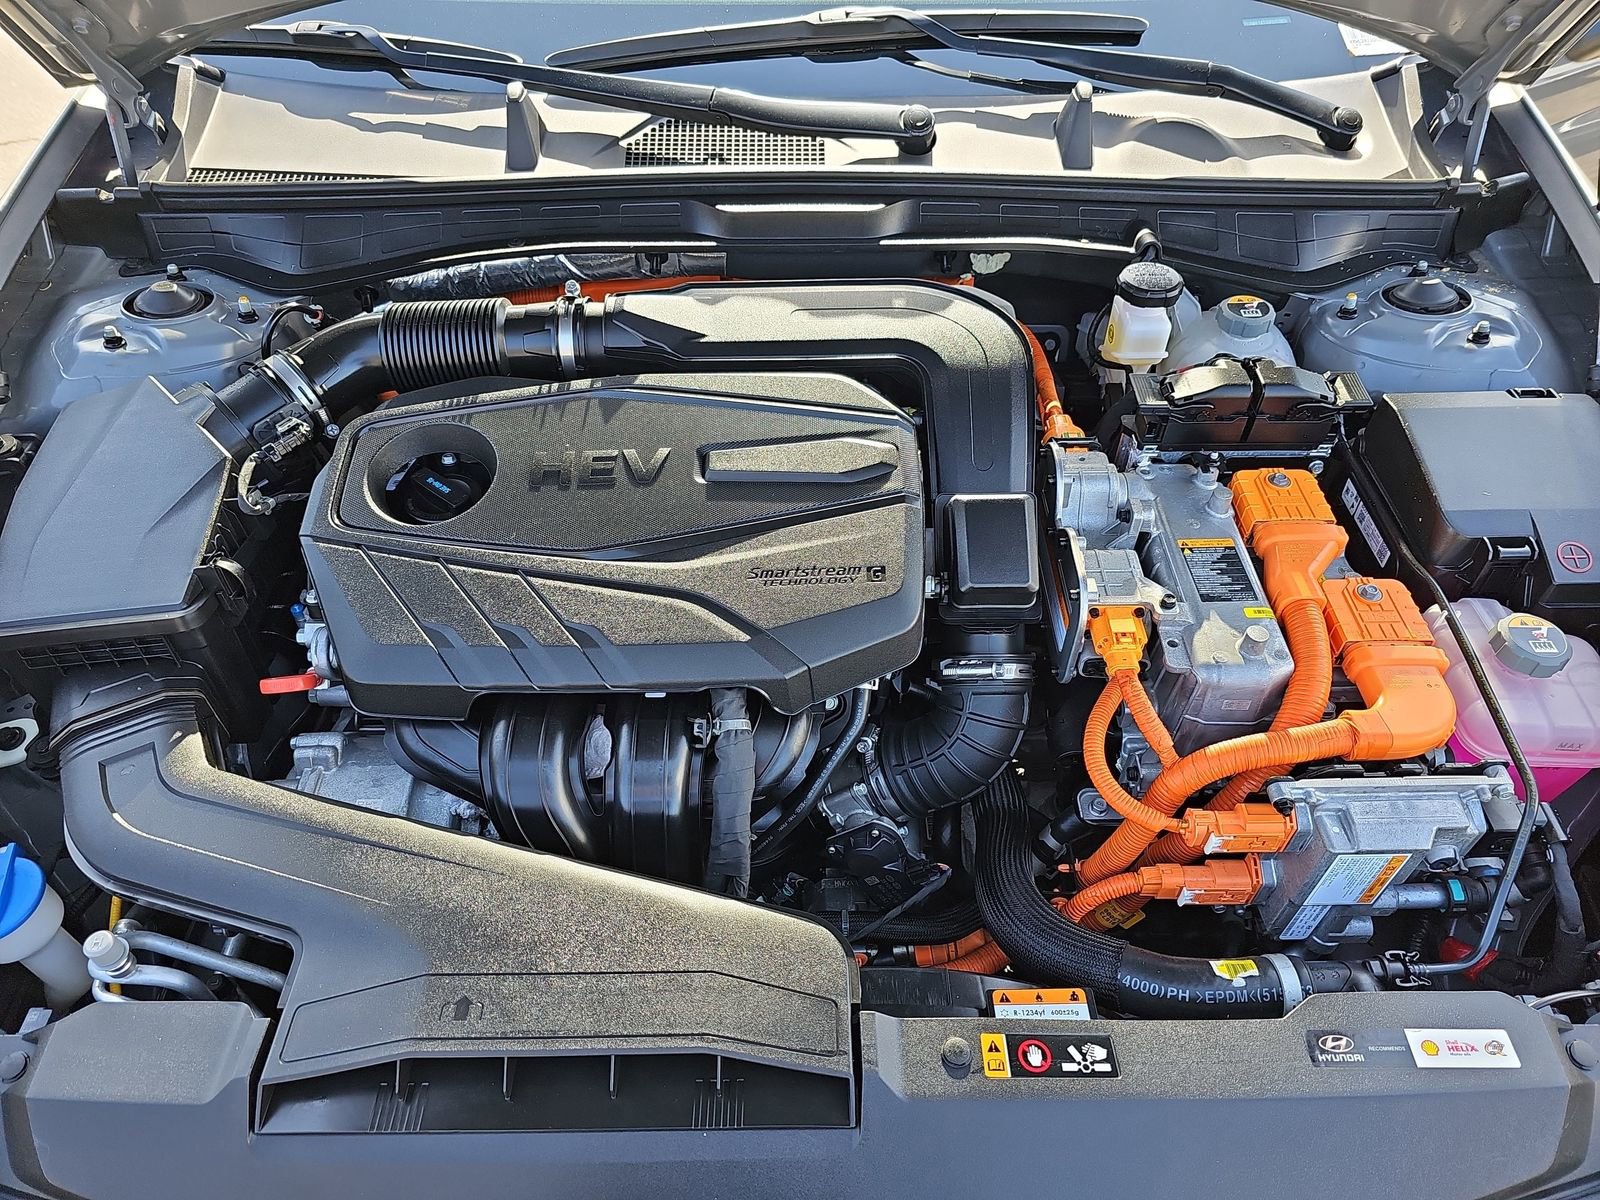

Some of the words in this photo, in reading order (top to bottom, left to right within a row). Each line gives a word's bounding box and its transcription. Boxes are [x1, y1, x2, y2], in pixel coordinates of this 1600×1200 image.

[530, 448, 671, 486] HEV
[747, 565, 862, 579] Smartstream
[762, 576, 858, 587] TECHNOLOGY
[1557, 742, 1584, 750] MAX
[1118, 972, 1190, 1002] 4000)PH
[1013, 1009, 1046, 1018] R-1234yf
[1447, 1045, 1479, 1053] HELIX
[1318, 1053, 1365, 1063] HYUNDAI
